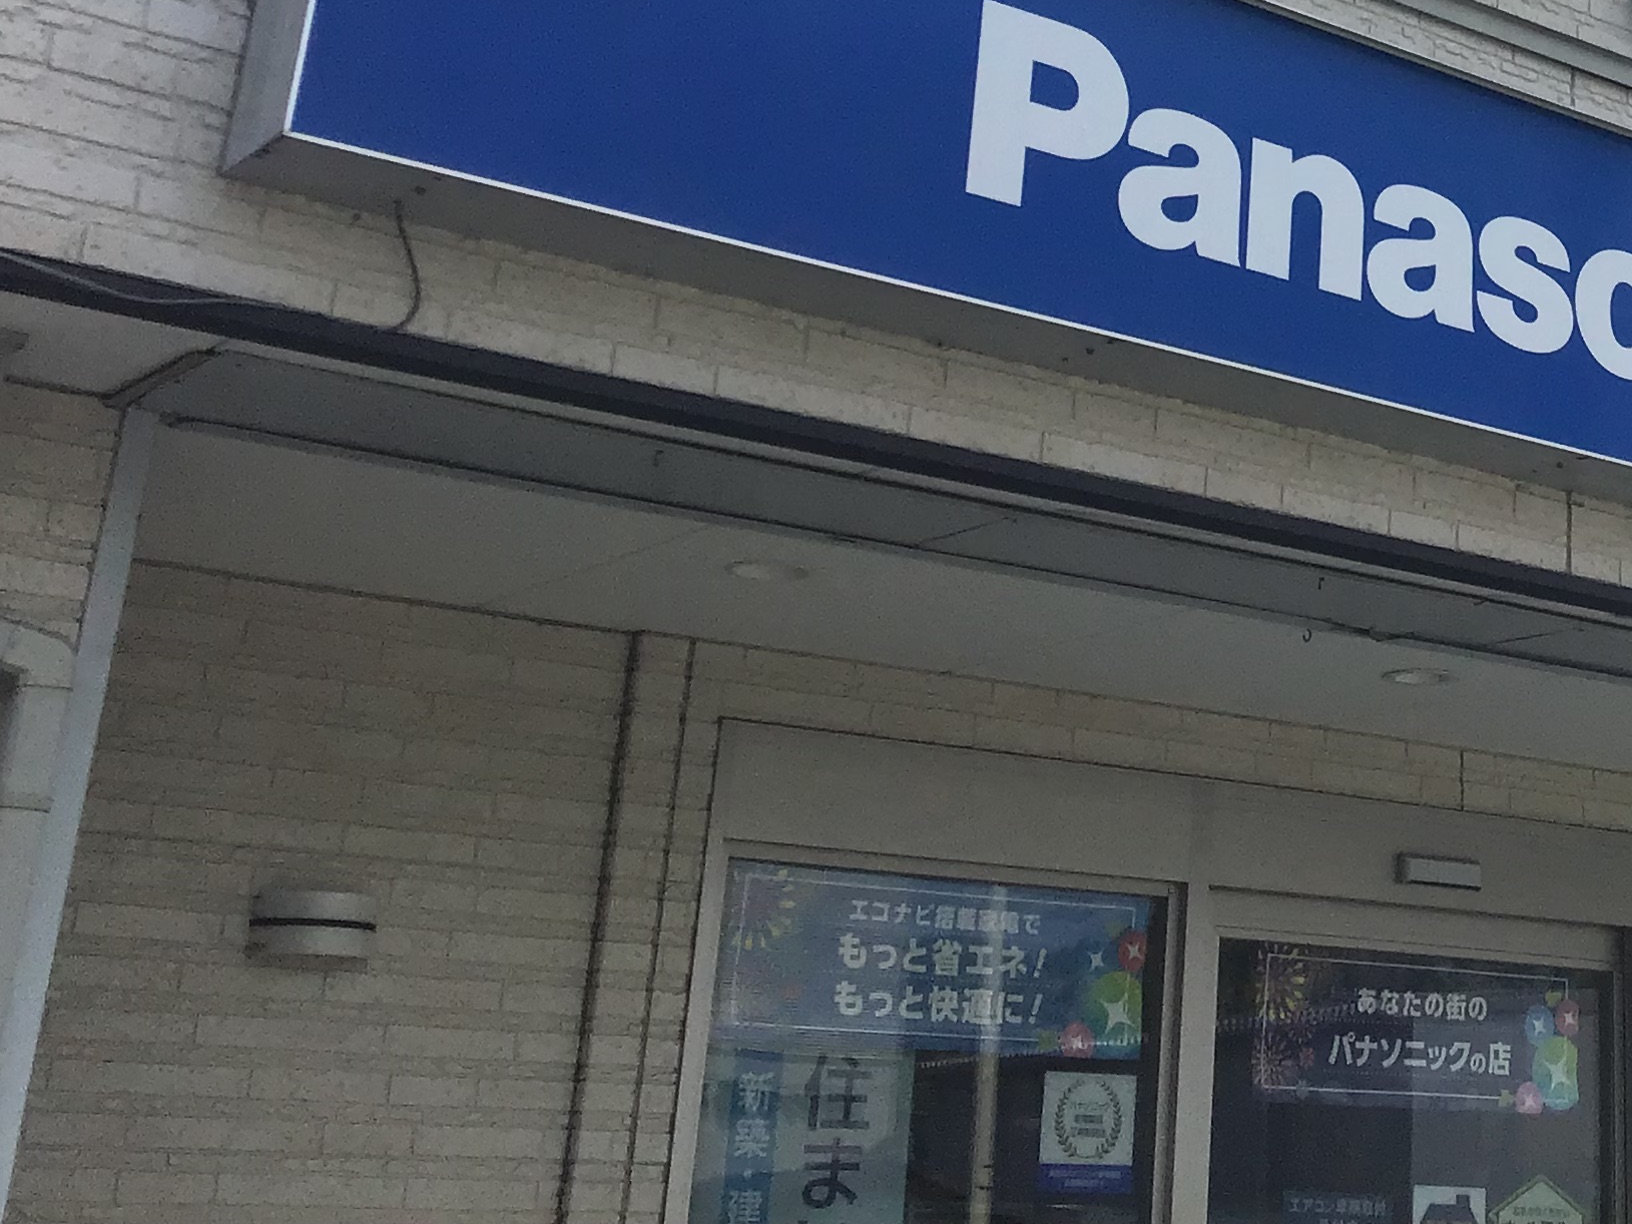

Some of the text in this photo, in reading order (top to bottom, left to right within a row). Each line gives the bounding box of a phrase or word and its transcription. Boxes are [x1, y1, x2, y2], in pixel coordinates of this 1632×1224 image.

[1356, 987, 1488, 1022] あなたの街の
[1327, 1031, 1513, 1077] パナソニックの店
[802, 1055, 871, 1223] 住ま
